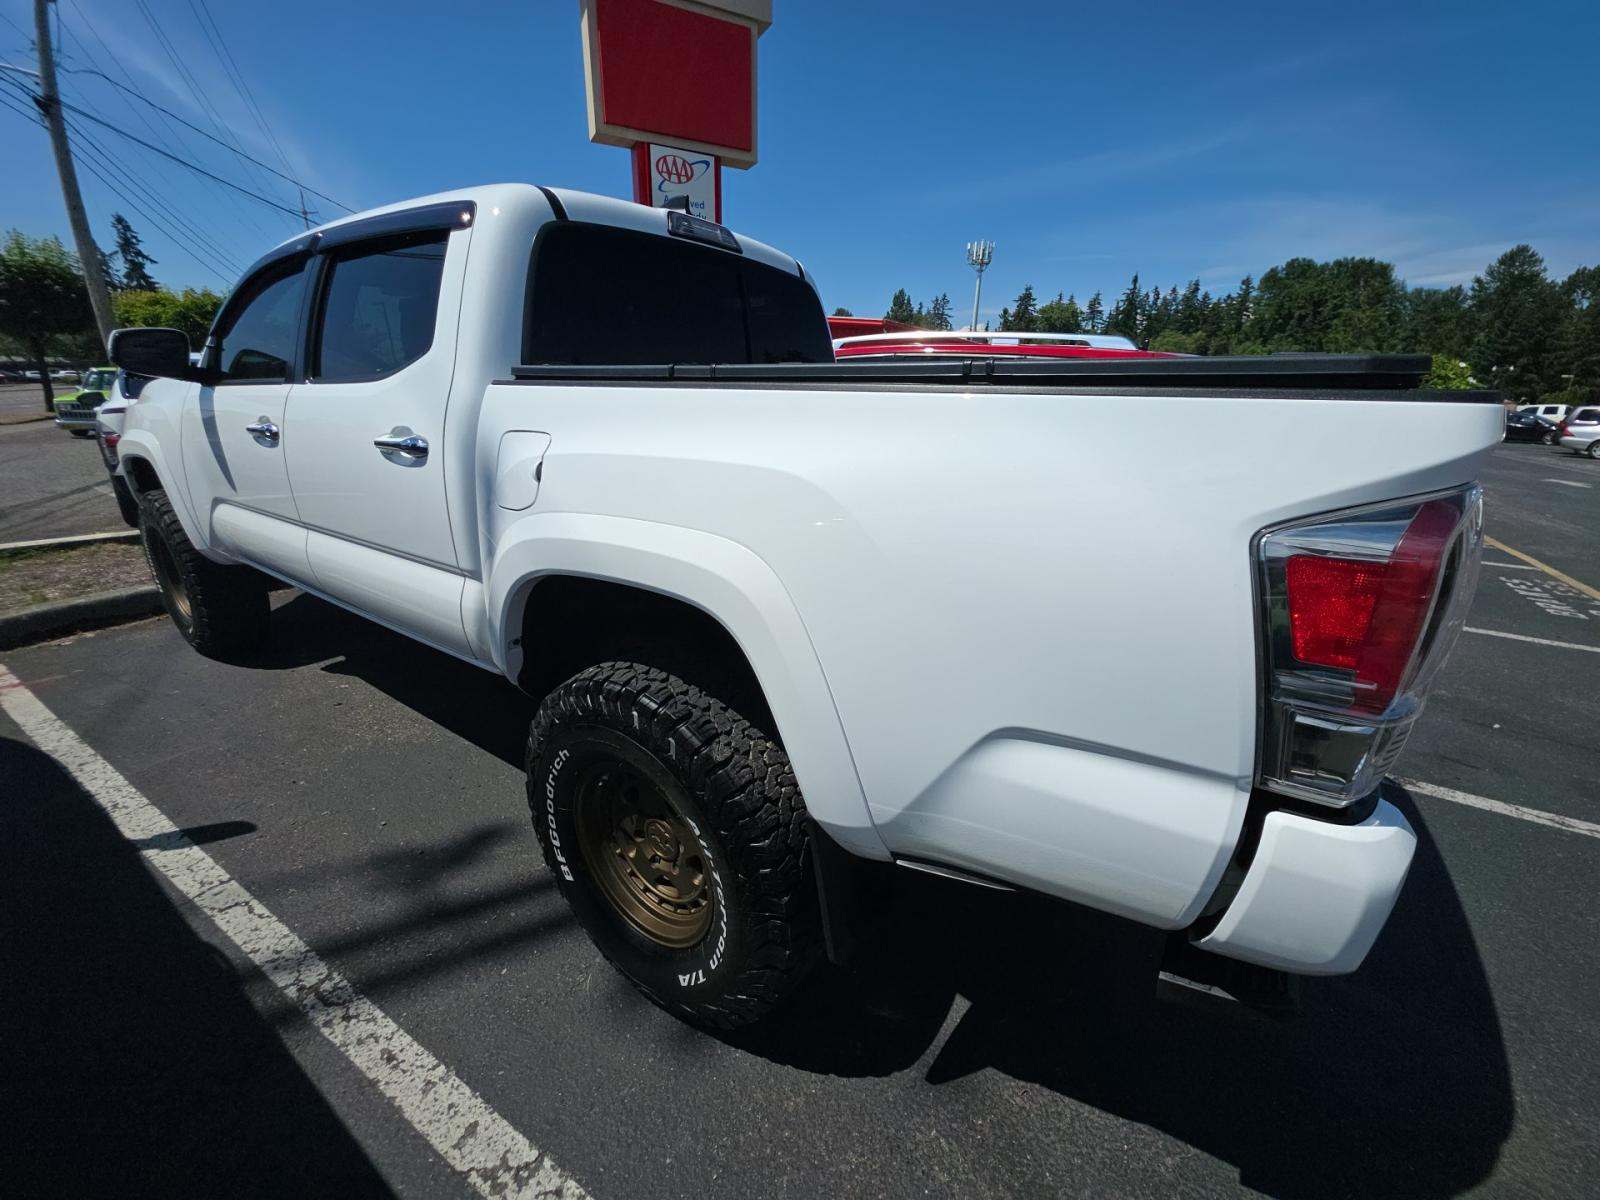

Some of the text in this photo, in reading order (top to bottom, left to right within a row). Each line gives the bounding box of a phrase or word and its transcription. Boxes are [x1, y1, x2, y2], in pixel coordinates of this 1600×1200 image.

[660, 156, 692, 184] AAA
[664, 195, 705, 209] Aved
[546, 749, 575, 882] BFGoodrich
[678, 969, 707, 987] T/A
